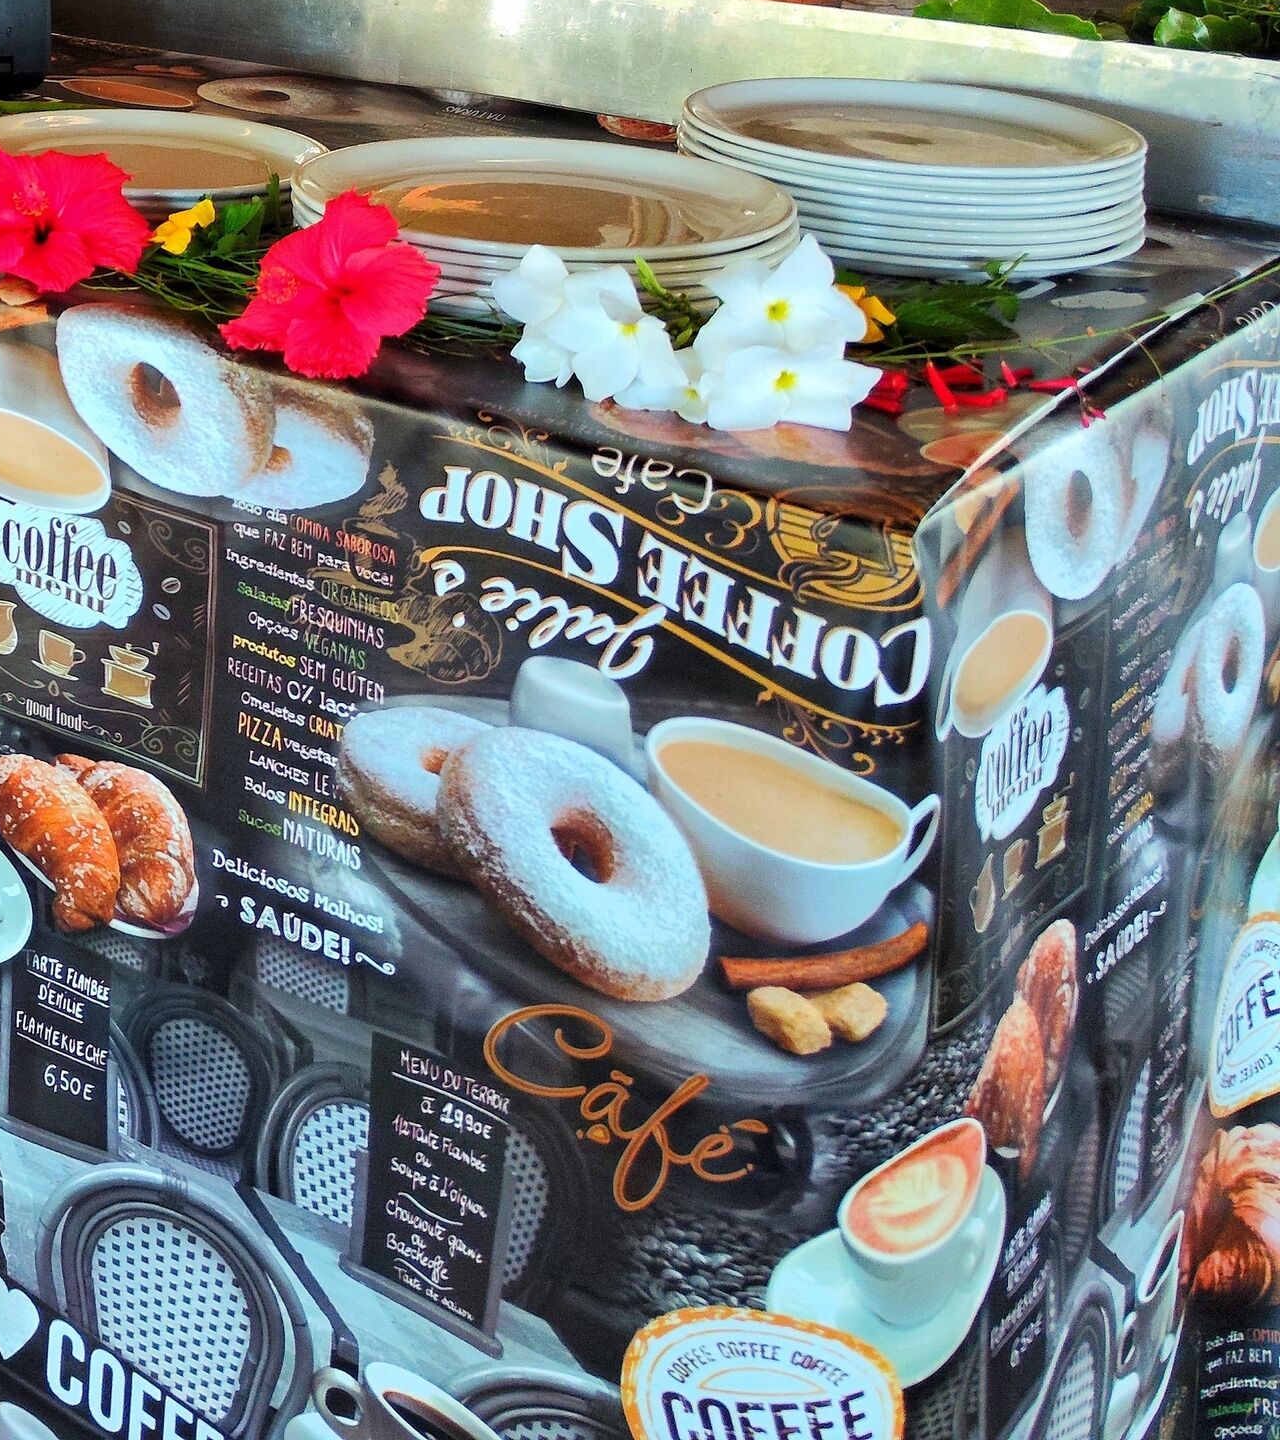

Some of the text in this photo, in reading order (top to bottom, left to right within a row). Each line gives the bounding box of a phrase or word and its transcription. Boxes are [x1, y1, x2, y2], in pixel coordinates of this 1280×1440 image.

[233, 522, 260, 539] que
[264, 528, 286, 551] FAZ
[291, 538, 312, 560] BEM
[317, 552, 351, 572] para
[290, 514, 330, 543] COMIDA
[335, 530, 396, 566] SABOROSA
[418, 465, 625, 585] SHOP
[2, 517, 117, 600] coffee
[226, 548, 315, 591] Ingredientes
[16, 567, 105, 614] menu
[238, 581, 384, 649] Saladas FRESQUINHAS
[638, 532, 931, 707] COFFEE
[227, 656, 312, 705] RECEITAS 0%
[233, 634, 296, 668] produtos
[300, 655, 326, 682] SEM
[26, 699, 82, 731] good food
[238, 711, 282, 752] PIZZA
[241, 690, 305, 728] Omeletes
[249, 750, 309, 786] LANCHES
[986, 699, 1053, 809] coffee
[244, 776, 286, 805] Bolos
[283, 818, 361, 871] NATURAIS
[212, 848, 384, 934] Deliciosos Molhos!
[239, 896, 351, 965] SAÚDE!
[400, 1050, 440, 1081] MENU
[1225, 1348, 1271, 1365] FAZ BEM
